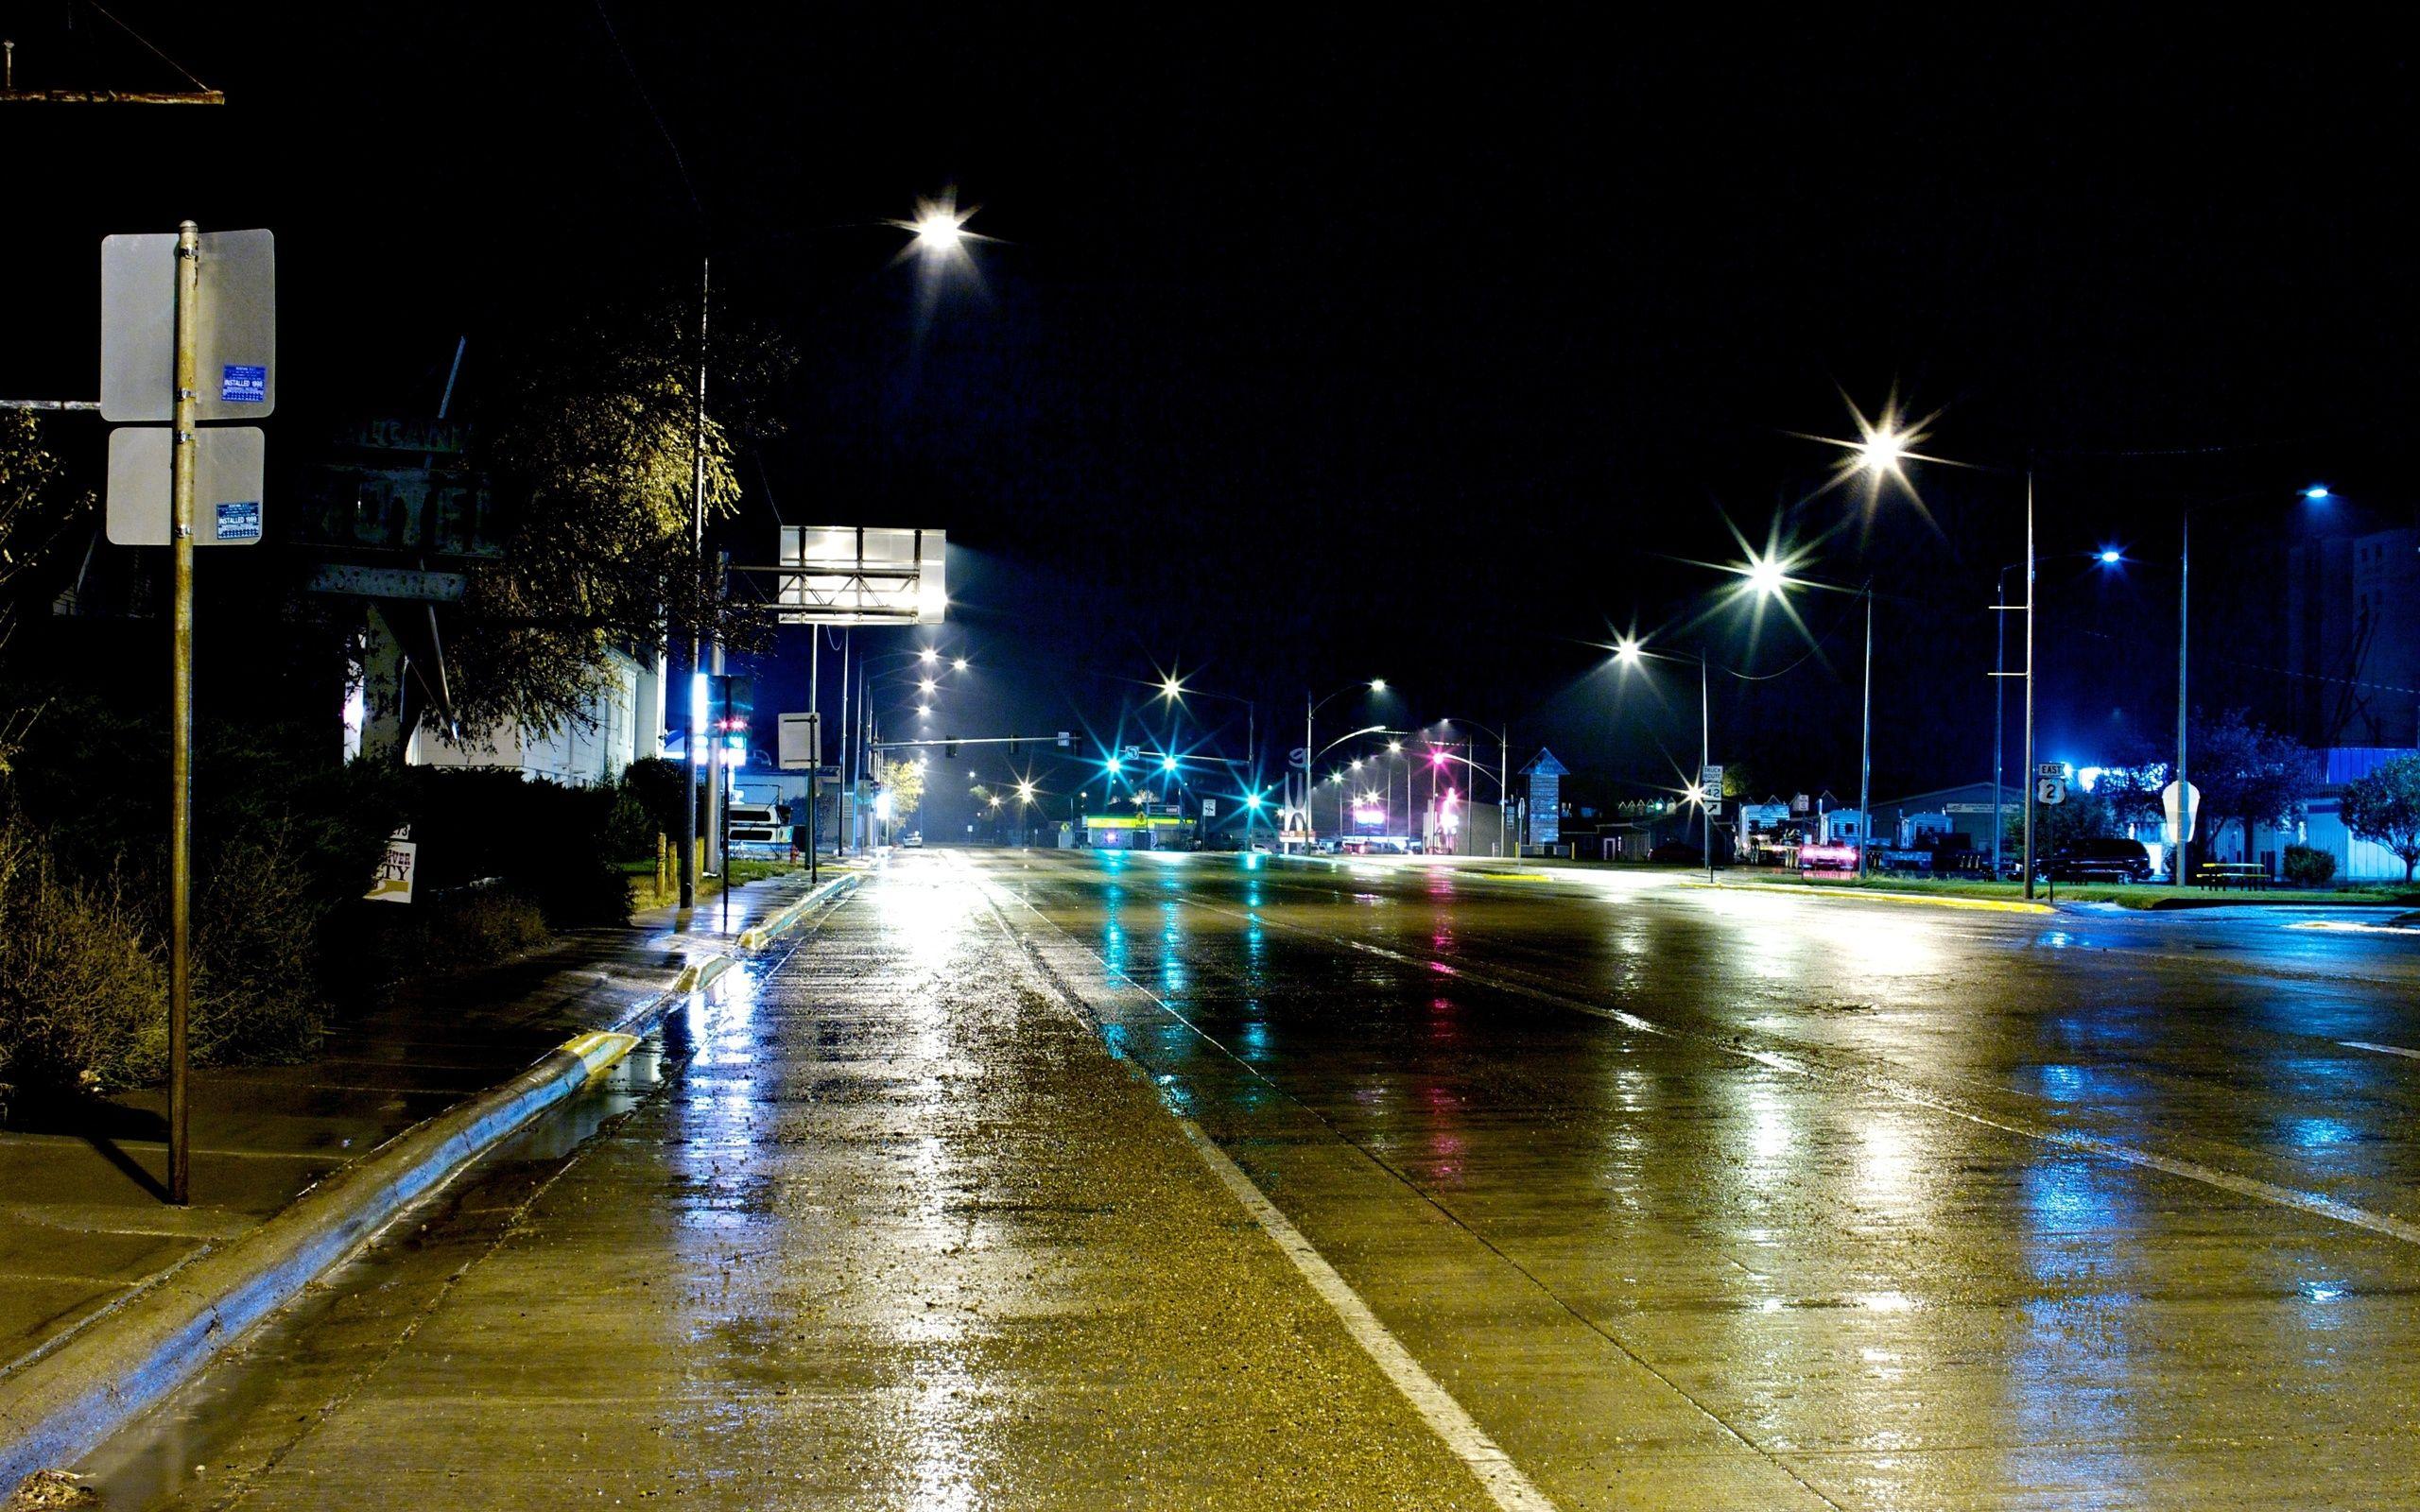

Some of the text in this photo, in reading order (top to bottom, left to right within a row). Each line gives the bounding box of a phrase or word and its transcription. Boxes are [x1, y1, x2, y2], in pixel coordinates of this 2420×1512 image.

[2042, 765, 2062, 774] EAST
[1705, 788, 1720, 799] 42
[2046, 783, 2056, 799] 2
